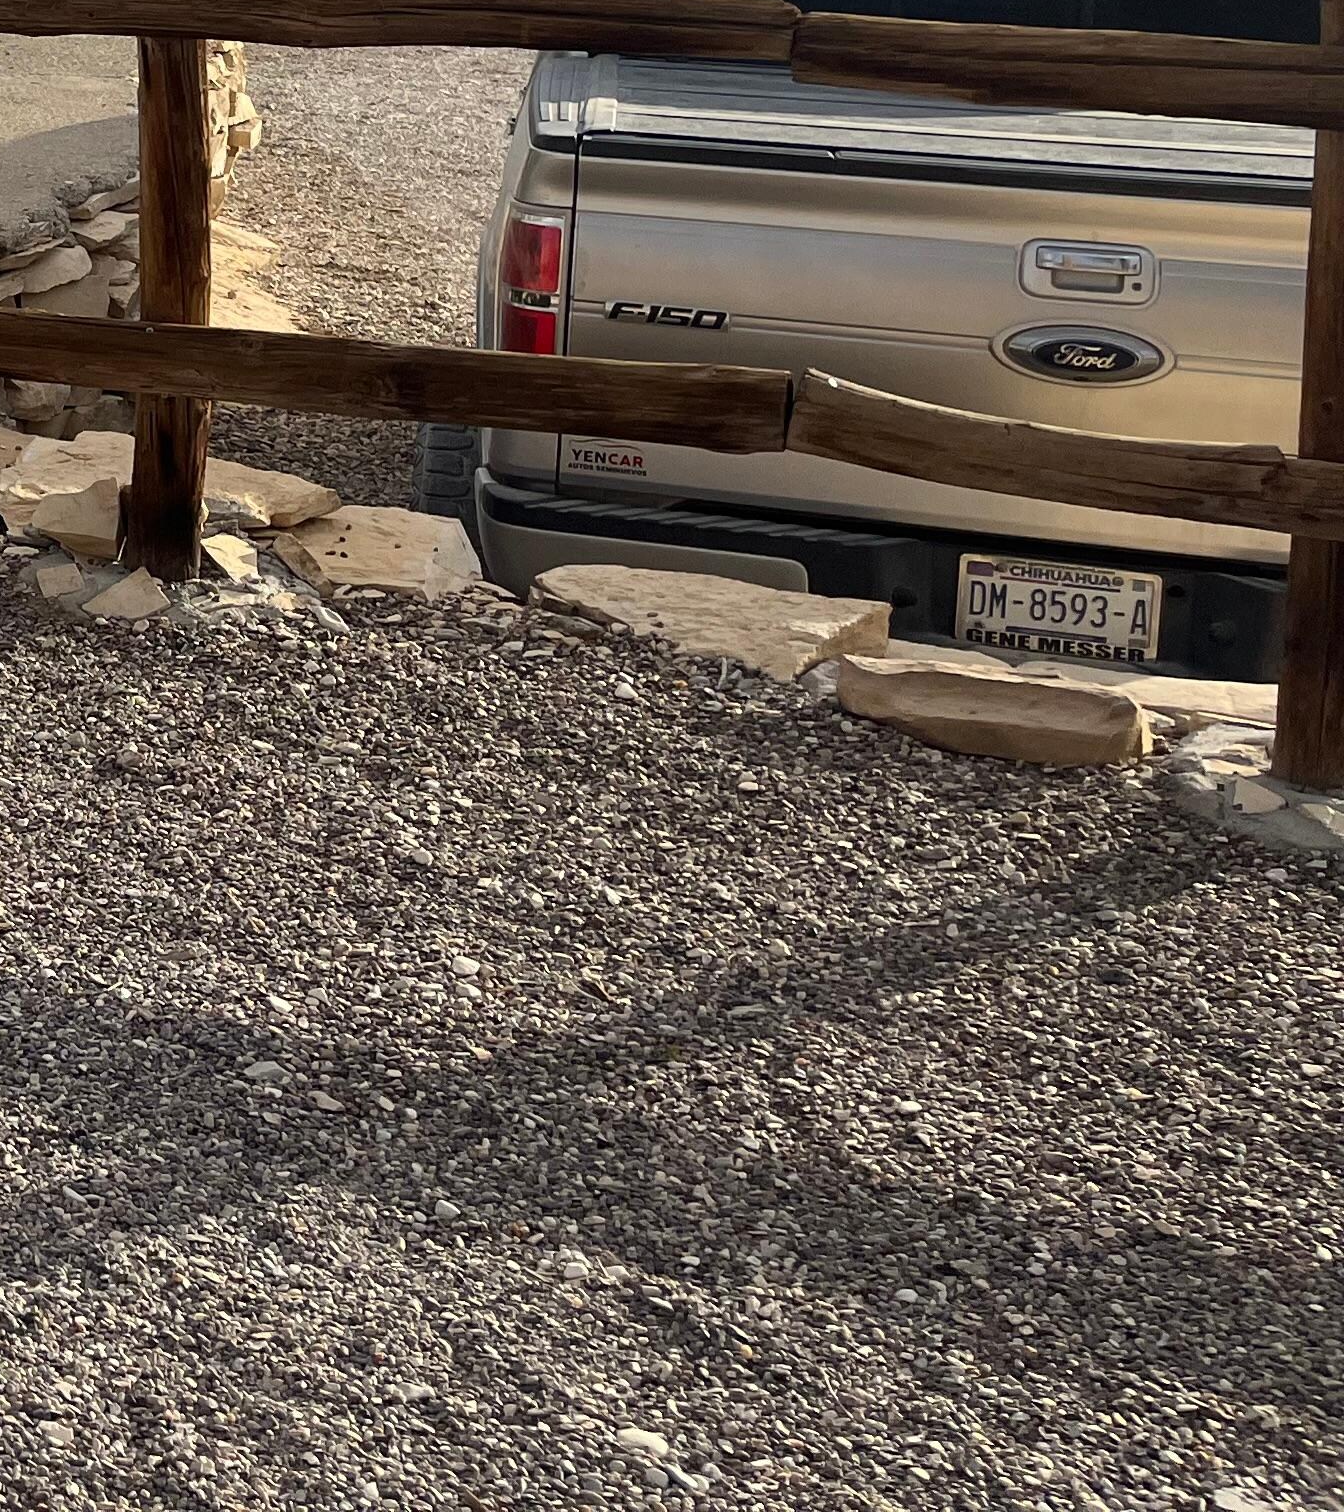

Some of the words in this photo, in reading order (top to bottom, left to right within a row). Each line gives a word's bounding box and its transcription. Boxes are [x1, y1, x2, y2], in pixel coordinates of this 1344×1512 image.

[607, 301, 728, 330] F-150
[1053, 343, 1116, 370] Ford
[571, 449, 644, 468] YENCAR
[1009, 565, 1111, 587] CHIHUAHUA
[969, 580, 1148, 636] DM-8593-A
[966, 628, 1031, 650] GENE
[1038, 636, 1145, 662] MESSER
